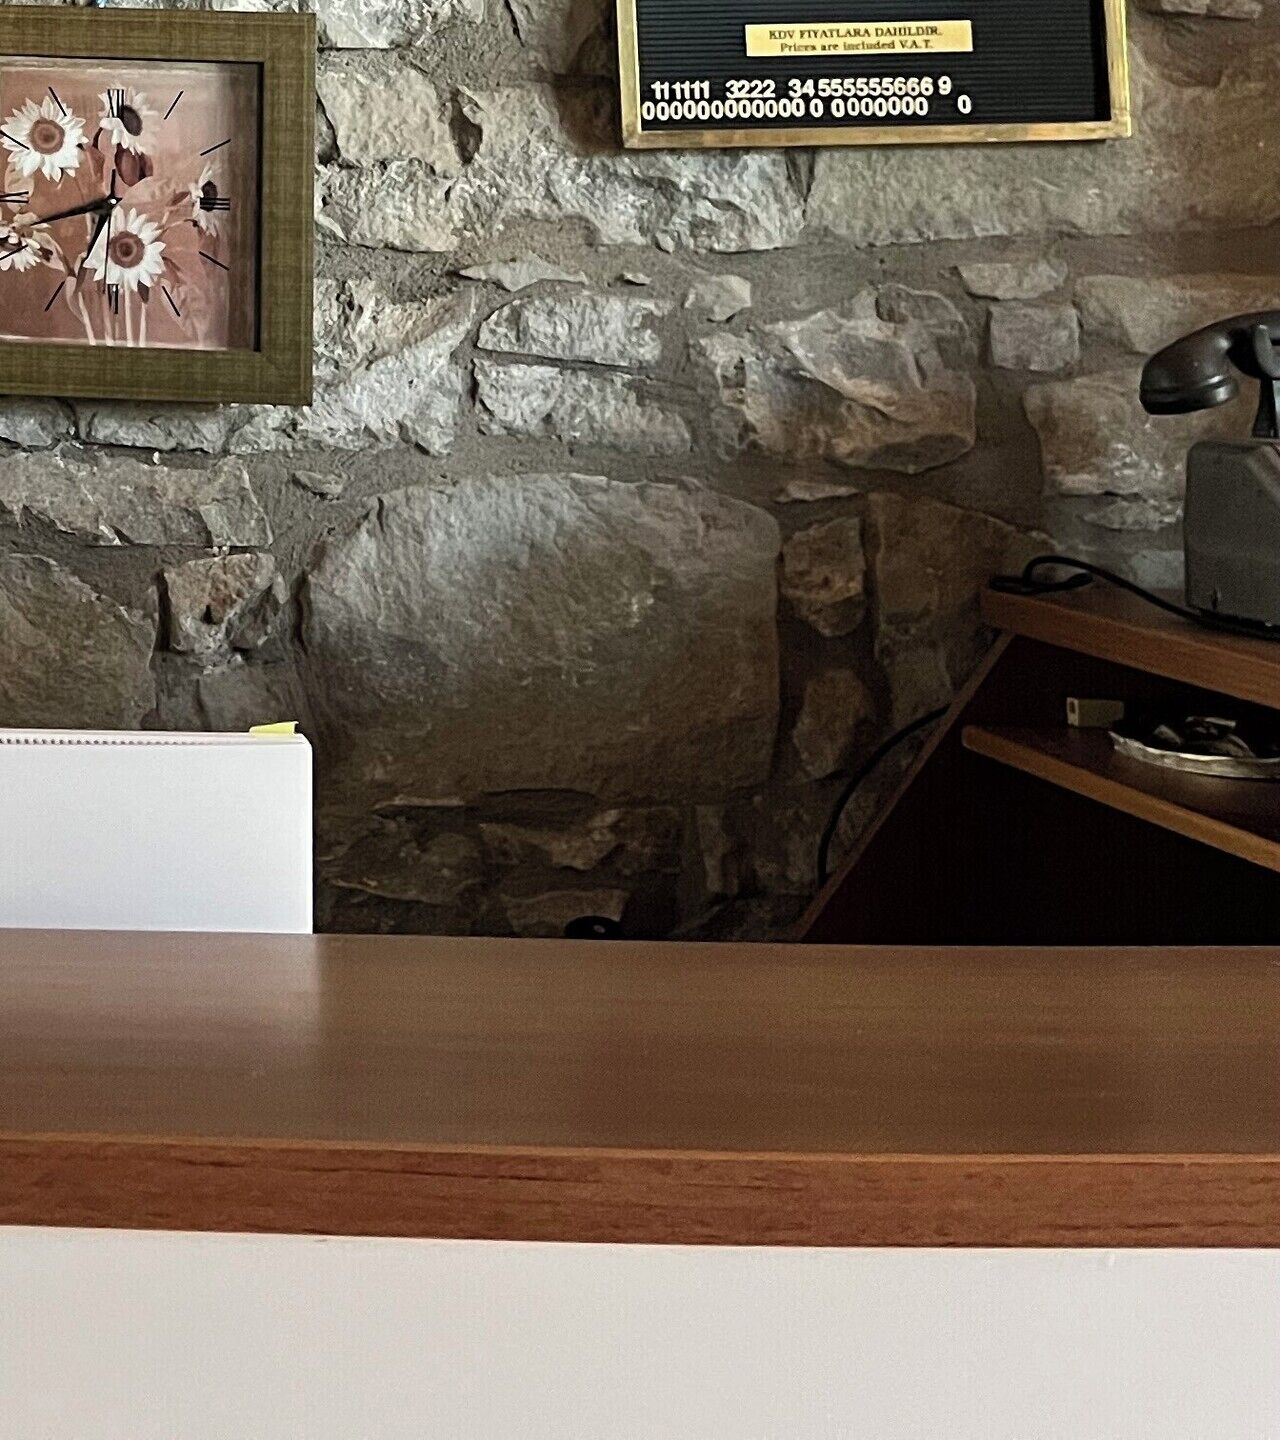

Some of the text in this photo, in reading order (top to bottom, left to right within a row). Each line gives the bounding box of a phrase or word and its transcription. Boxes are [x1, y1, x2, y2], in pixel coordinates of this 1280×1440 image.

[769, 30, 795, 40] KDV
[780, 43, 817, 53] Prices
[821, 42, 838, 51] are
[843, 40, 895, 51] included
[725, 79, 776, 99] 3222
[957, 95, 972, 114] 0
